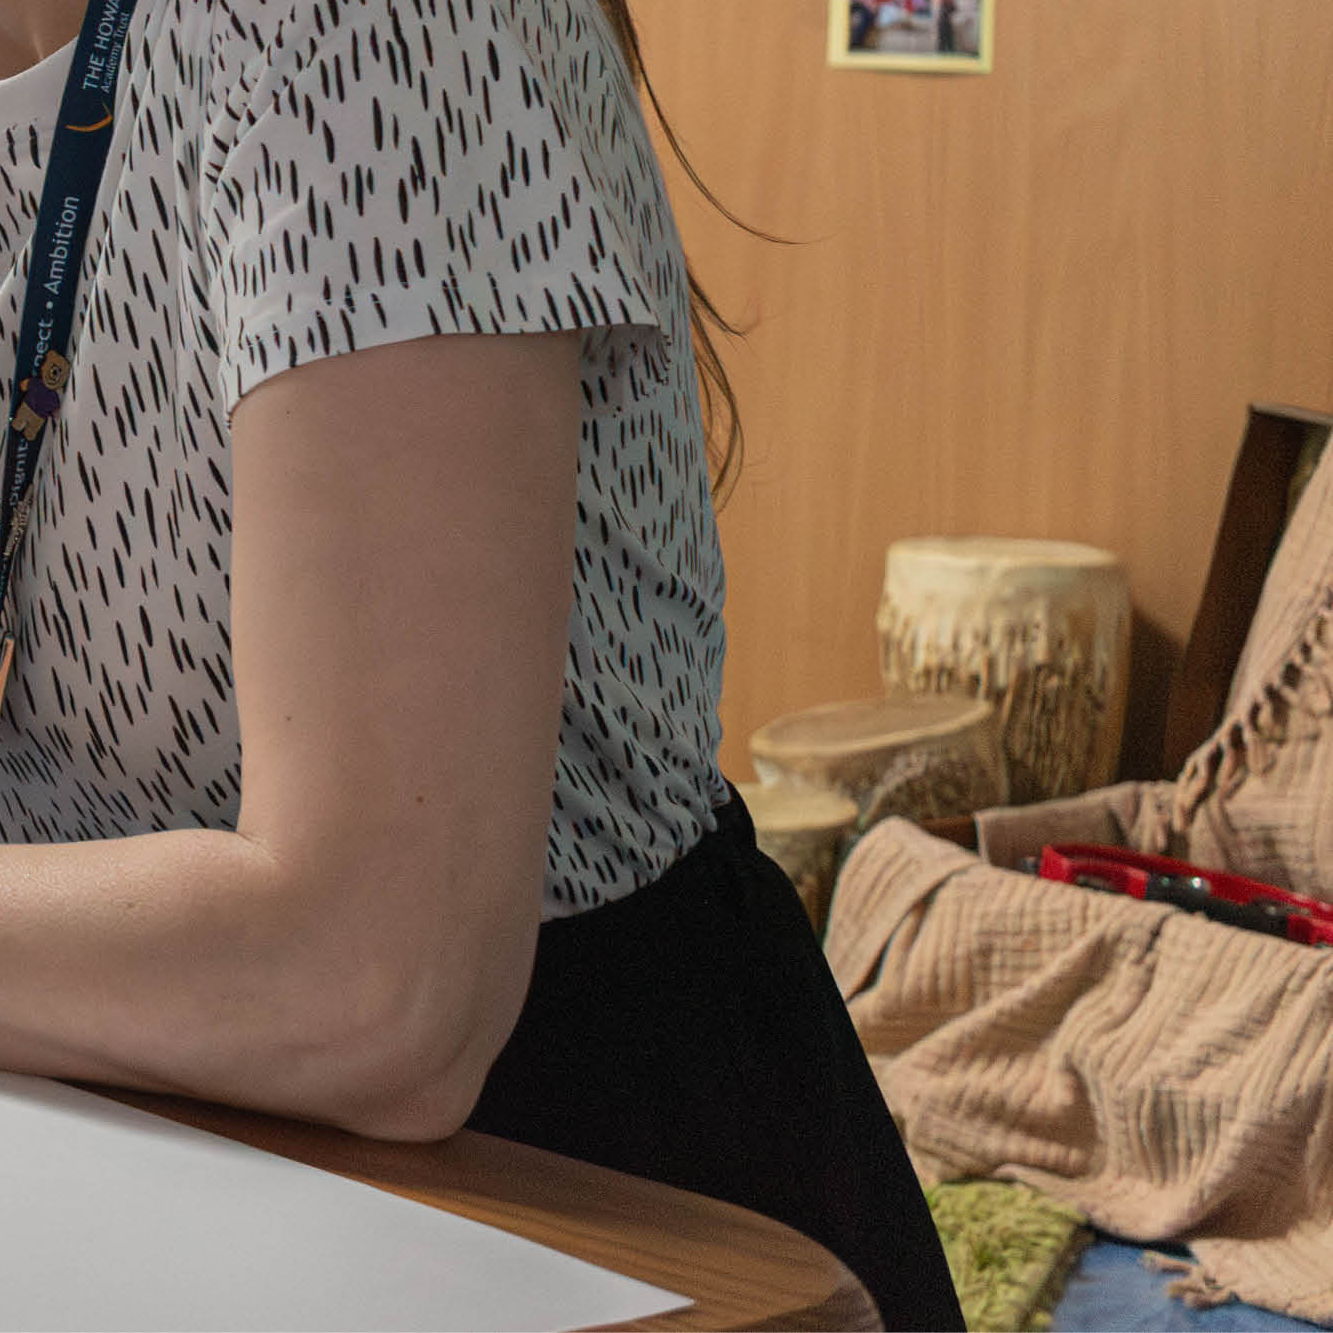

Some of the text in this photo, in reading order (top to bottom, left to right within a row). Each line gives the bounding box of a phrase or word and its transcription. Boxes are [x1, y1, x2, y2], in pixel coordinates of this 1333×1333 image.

[82, 52, 105, 90] THE
[101, 11, 131, 94] Academy Trust
[43, 195, 80, 296] Ambition
[9, 438, 30, 507] Dignit
